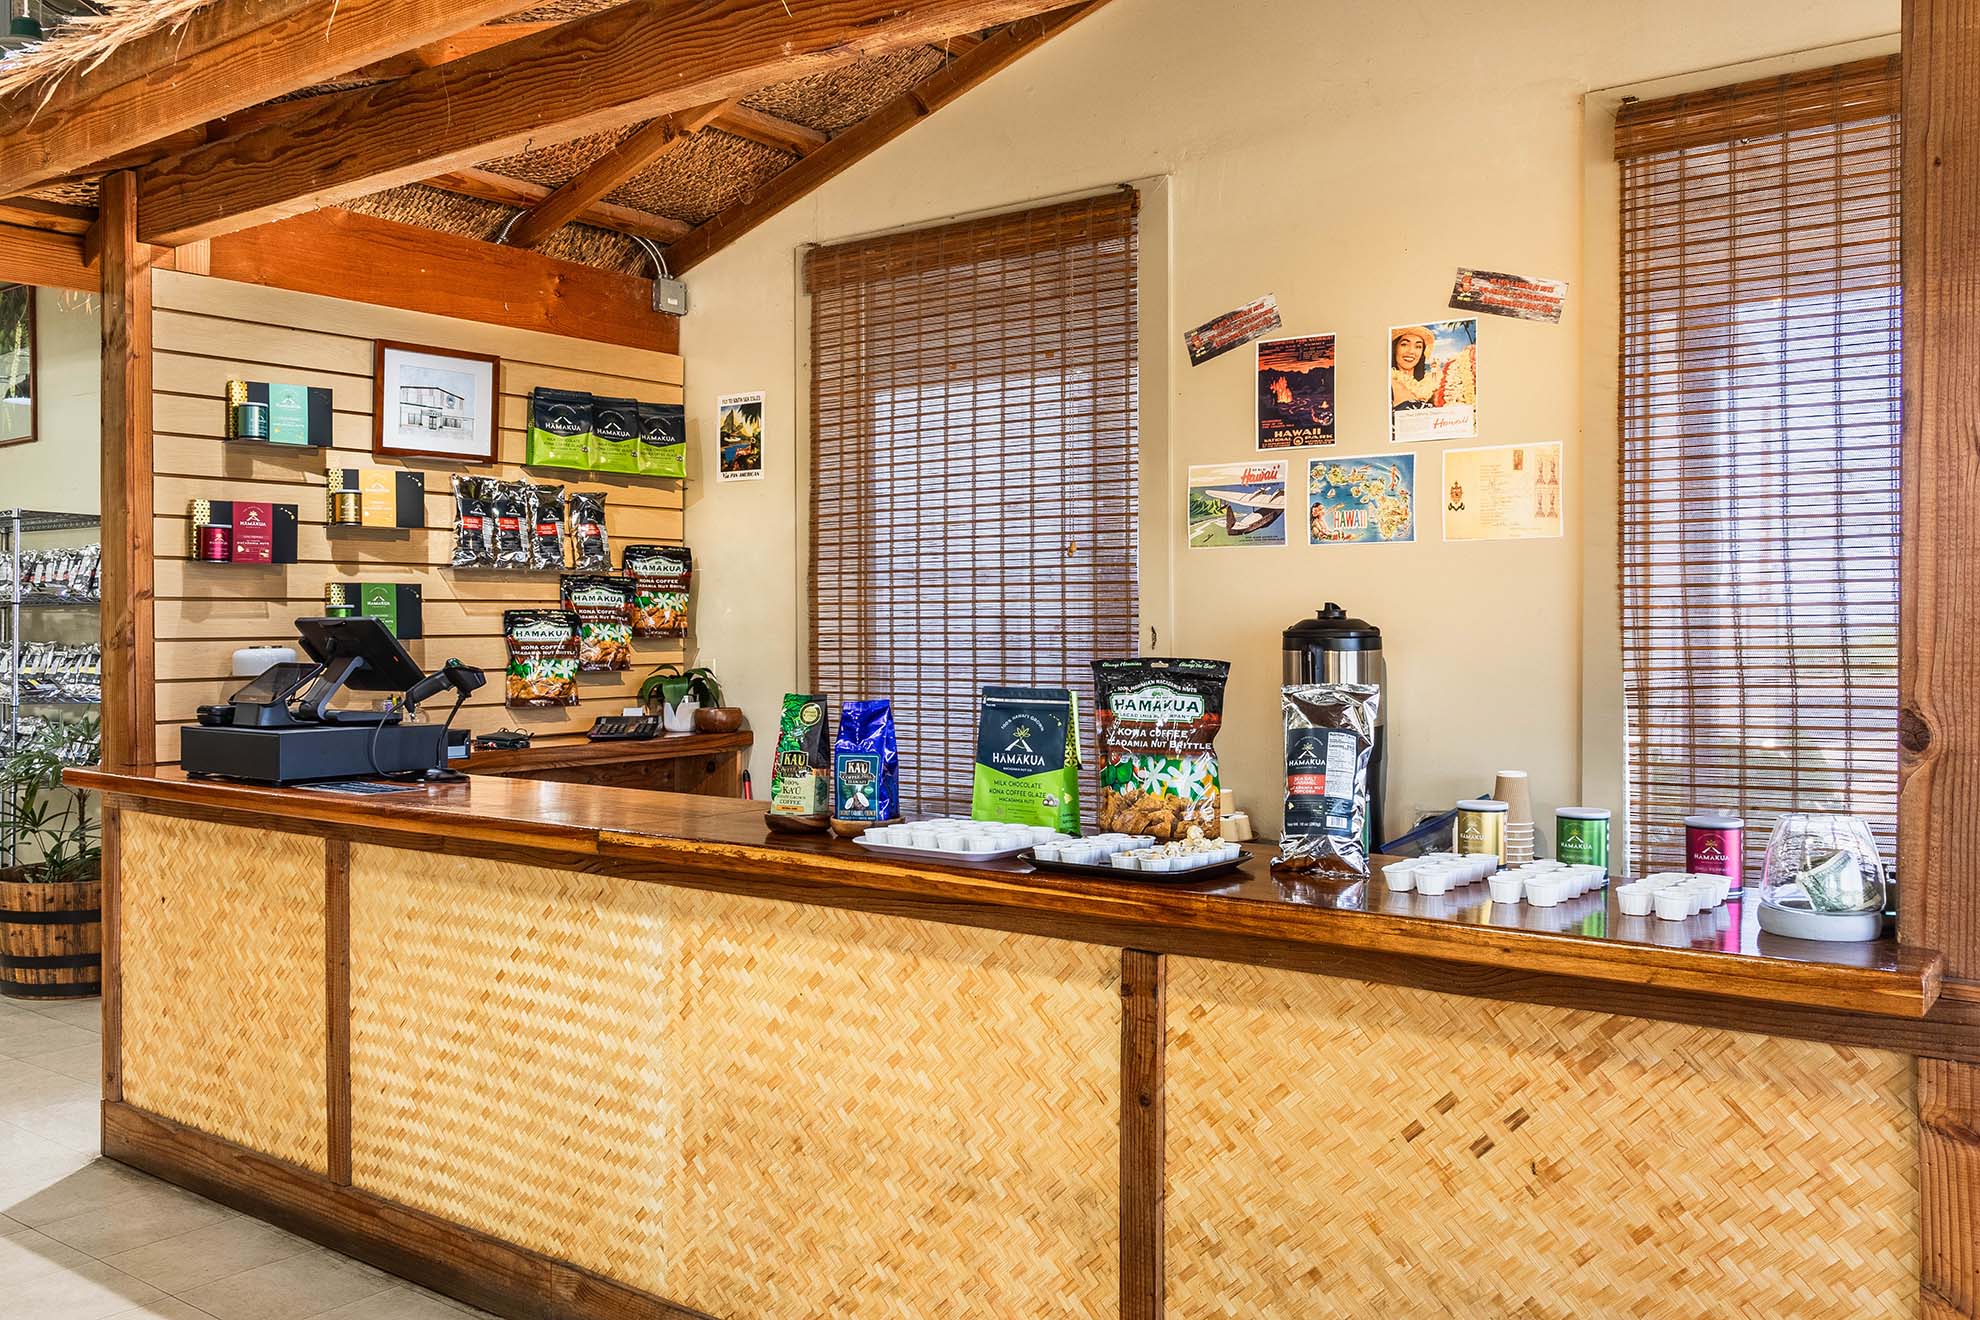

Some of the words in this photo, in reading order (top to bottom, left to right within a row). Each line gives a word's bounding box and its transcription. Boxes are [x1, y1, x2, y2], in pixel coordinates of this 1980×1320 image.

[1274, 428, 1321, 438] HAWAII
[1241, 464, 1280, 487] Hawaii
[1333, 509, 1368, 528] HAWAII
[574, 595, 622, 603] HAMAKUA
[1114, 699, 1199, 713] HAMAKUA
[1117, 727, 1147, 738] KONA
[1149, 728, 1189, 740] COFFEE
[1151, 739, 1167, 748] NUT
[1169, 740, 1212, 750] BRITTLE
[1008, 781, 1042, 789] CHOCOLATE
[1006, 789, 1026, 797] COFFEE
[1027, 790, 1047, 798] GLAZE
